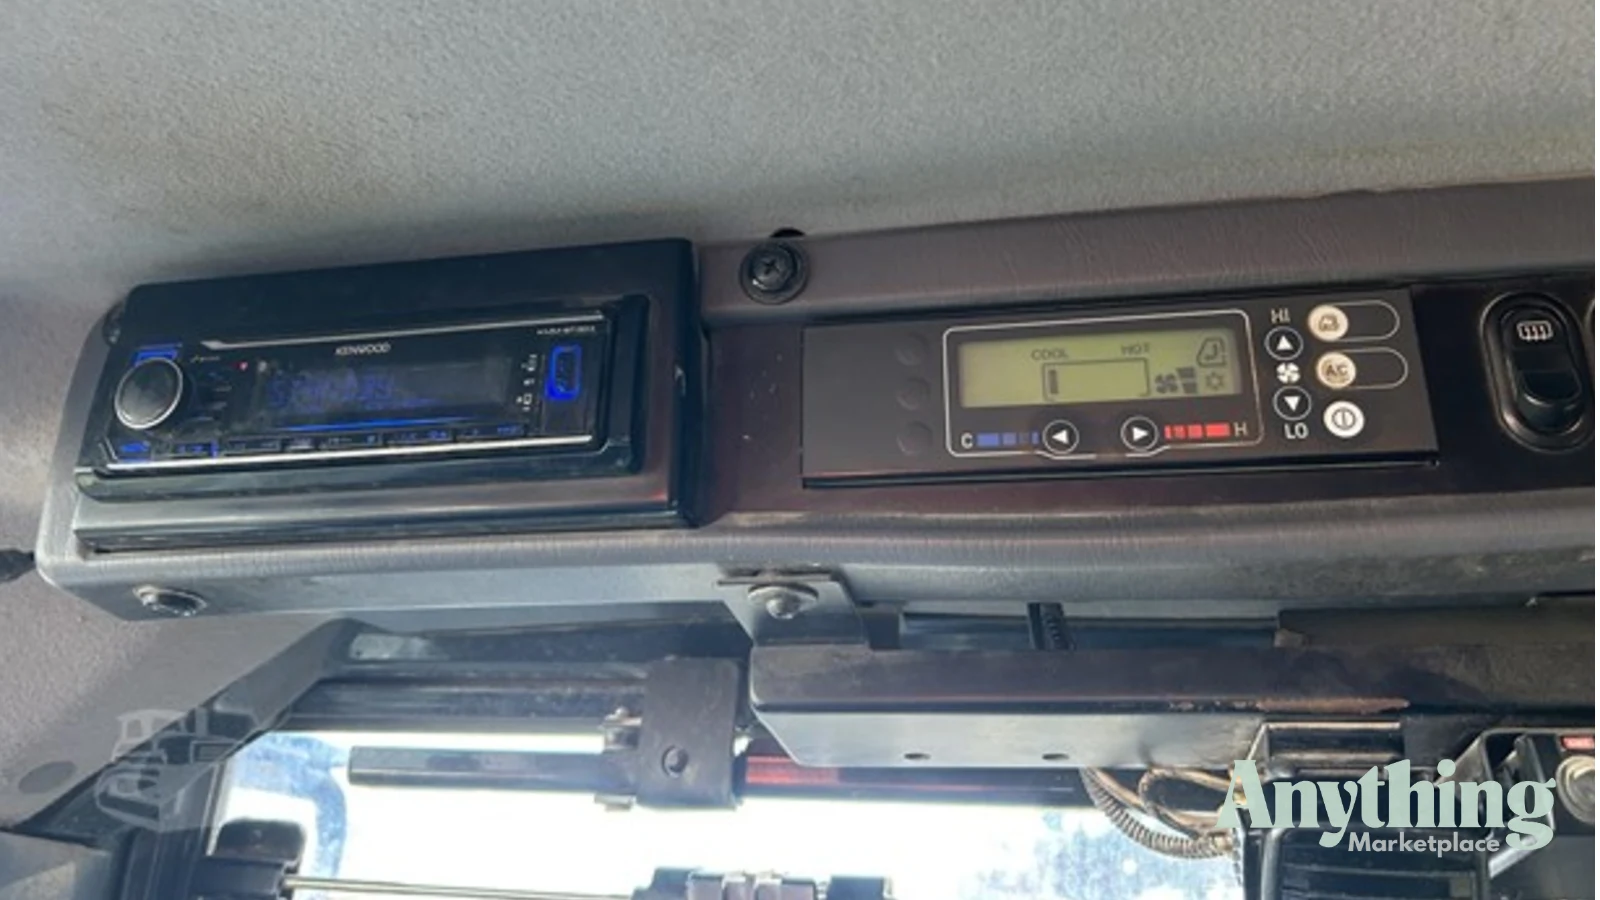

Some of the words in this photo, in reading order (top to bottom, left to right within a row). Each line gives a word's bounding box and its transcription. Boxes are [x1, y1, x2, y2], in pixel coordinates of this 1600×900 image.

[1271, 307, 1291, 324] HI
[335, 342, 391, 356] KENWOOD
[1030, 348, 1069, 361] COOL
[1120, 342, 1150, 356] HOT
[1233, 422, 1247, 437] H
[1284, 422, 1309, 439] LO
[961, 433, 973, 448] C
